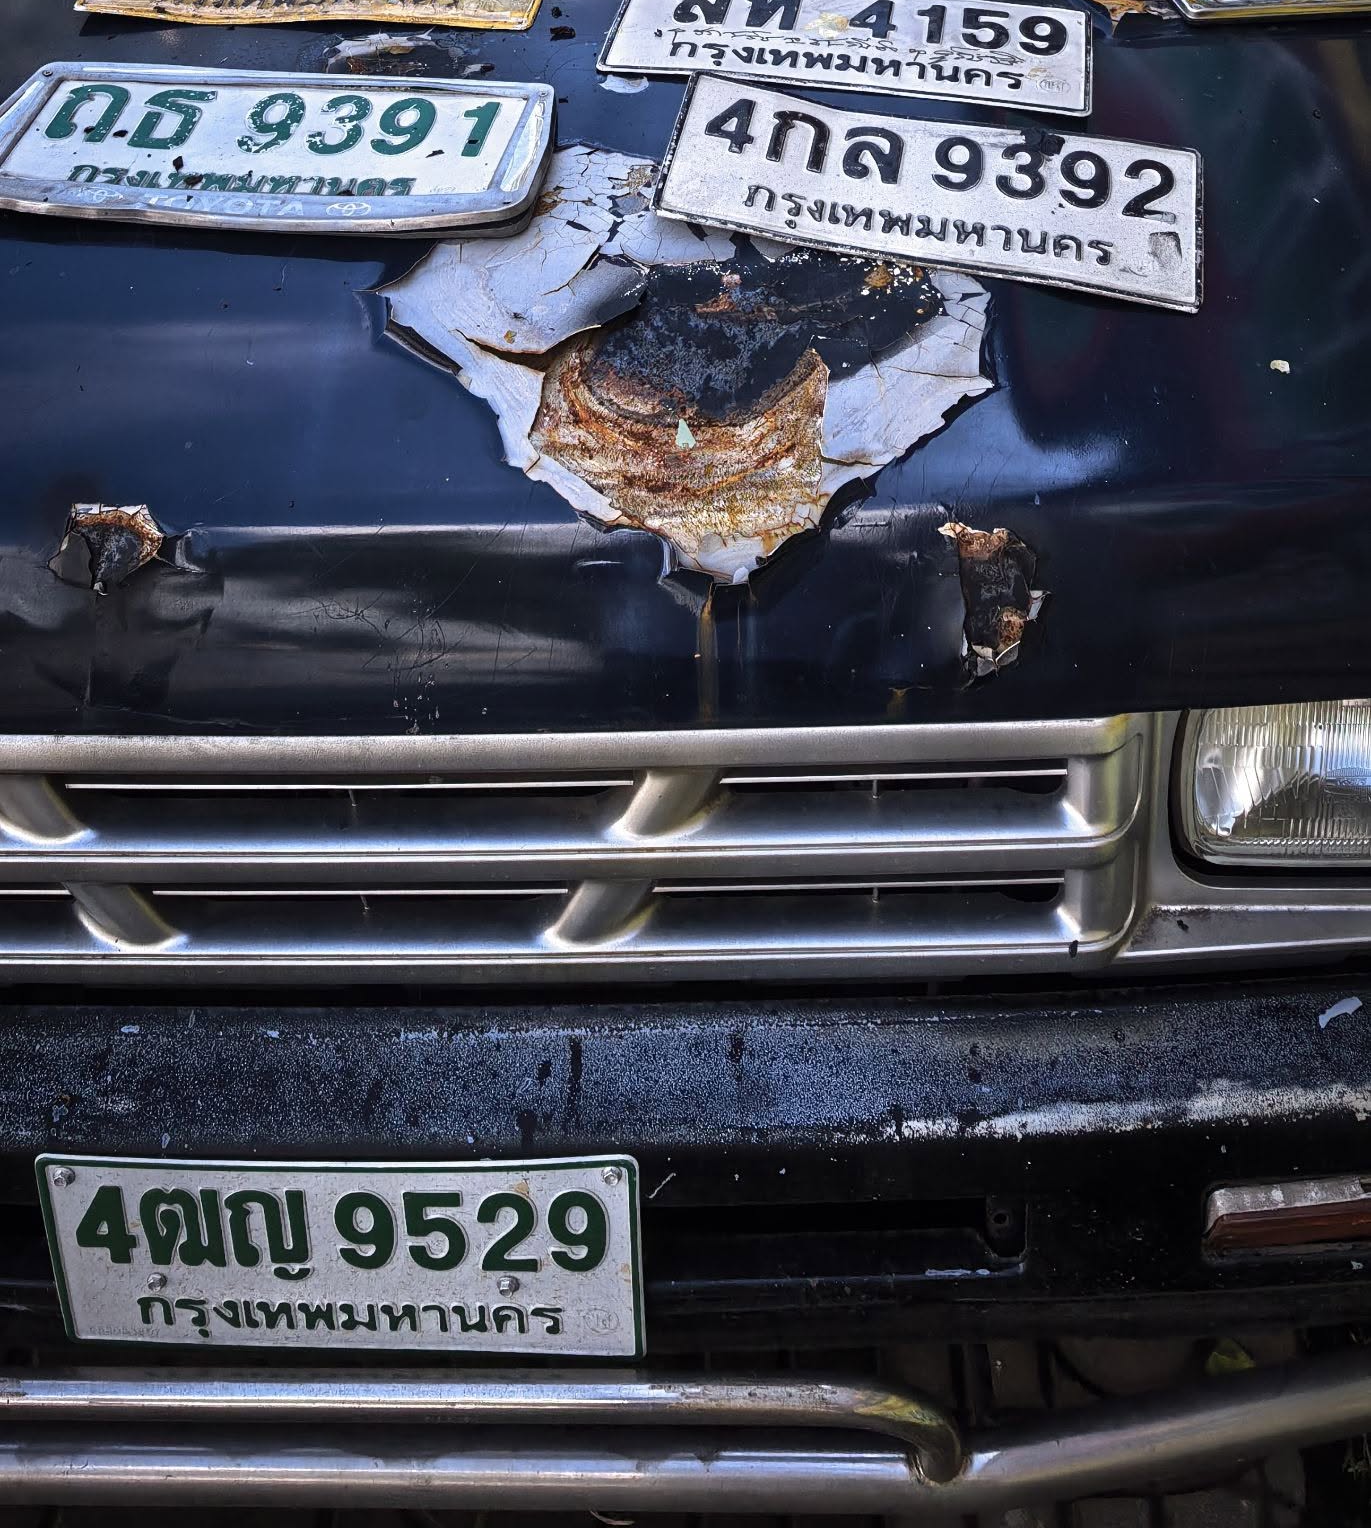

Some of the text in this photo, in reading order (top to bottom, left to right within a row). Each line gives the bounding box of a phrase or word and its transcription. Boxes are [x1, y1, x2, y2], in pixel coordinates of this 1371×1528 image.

[668, 39, 1025, 91] กรุงเทพมหานคร
[44, 83, 502, 159] ถธ 9391
[704, 97, 1179, 225] 4กล 9392
[145, 192, 305, 216] TOYOTA
[743, 183, 1116, 266] กรุงเทพมหานคร
[75, 1184, 609, 1281] 4ฒญ 9529
[136, 1295, 565, 1338] กรุงเทพมหานคร
